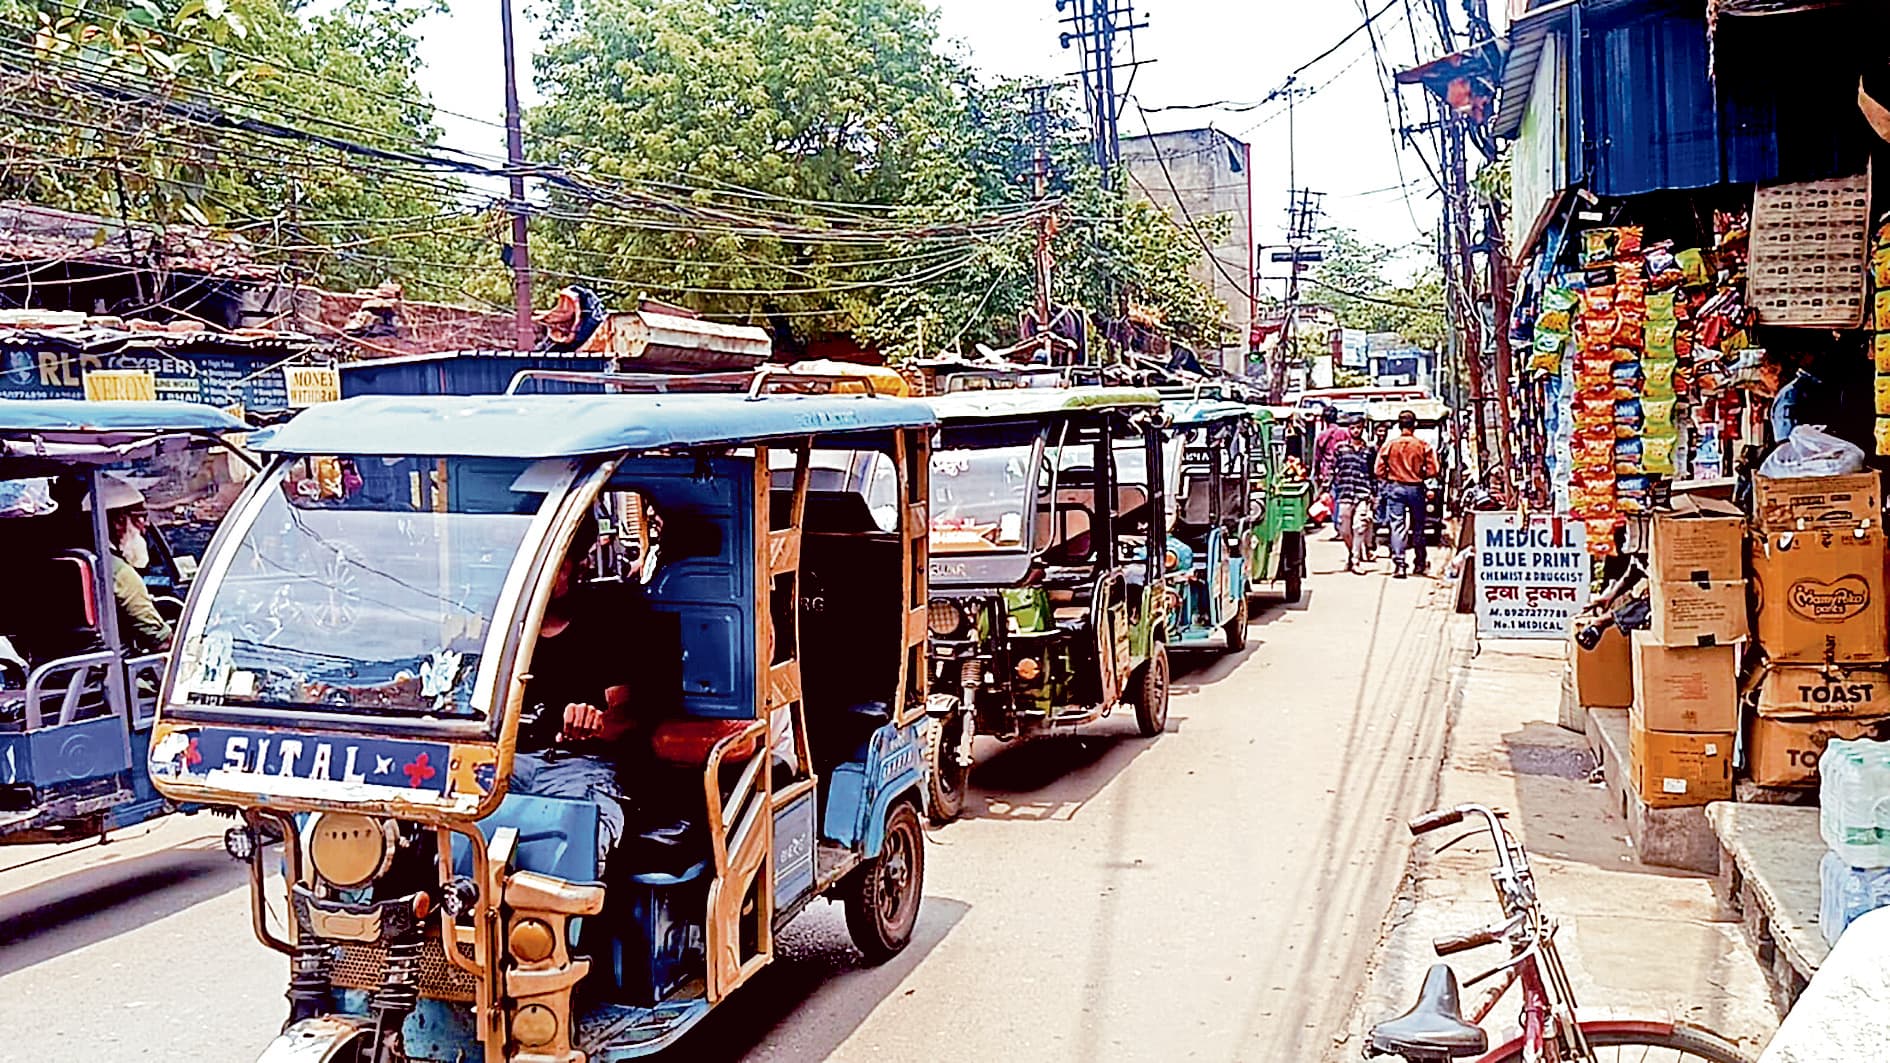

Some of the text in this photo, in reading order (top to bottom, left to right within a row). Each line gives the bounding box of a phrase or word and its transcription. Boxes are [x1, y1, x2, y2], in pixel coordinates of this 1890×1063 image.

[294, 371, 335, 387] MONEY
[1486, 529, 1577, 548] MEDICL
[1482, 552, 1581, 568] BLUE PRINT
[1480, 571, 1523, 581] CHEMIST
[1484, 585, 1578, 608] दवा दुकान
[1518, 620, 1563, 630] MEDICAL
[1798, 684, 1874, 704] TOAST
[223, 735, 367, 785] SITAL
